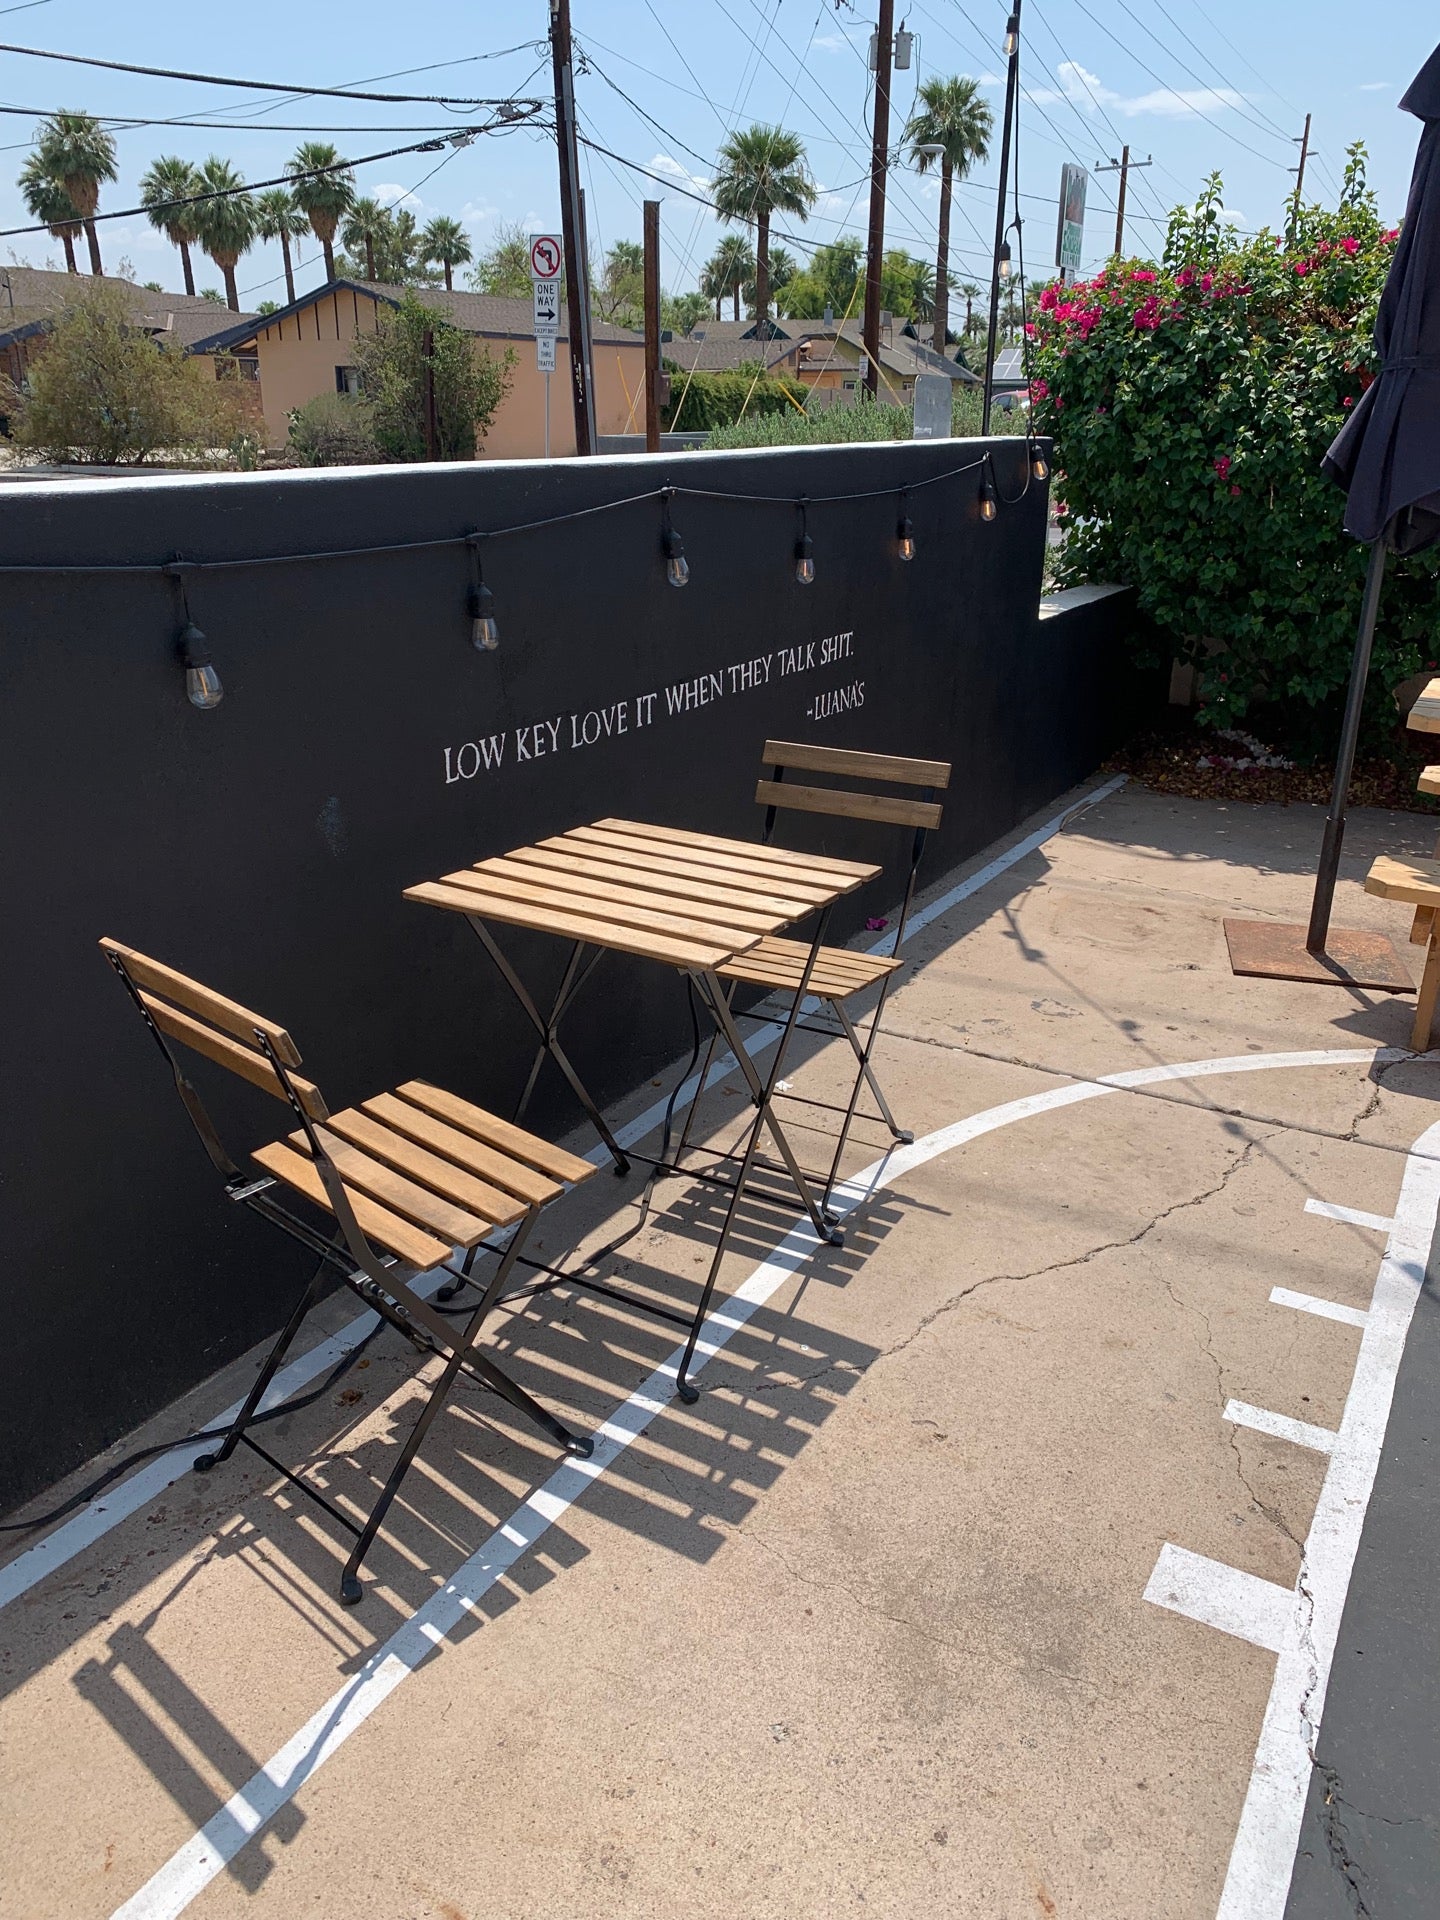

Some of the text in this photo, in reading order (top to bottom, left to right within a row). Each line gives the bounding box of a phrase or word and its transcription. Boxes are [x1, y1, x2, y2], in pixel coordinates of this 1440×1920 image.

[537, 284, 555, 295] ONE
[537, 295, 555, 306] WAY
[542, 341, 550, 349] NO
[538, 360, 555, 368] TRAFFIC
[443, 631, 854, 784] LOW KEY LOVE IT WHEN THEY TALK SHIT.
